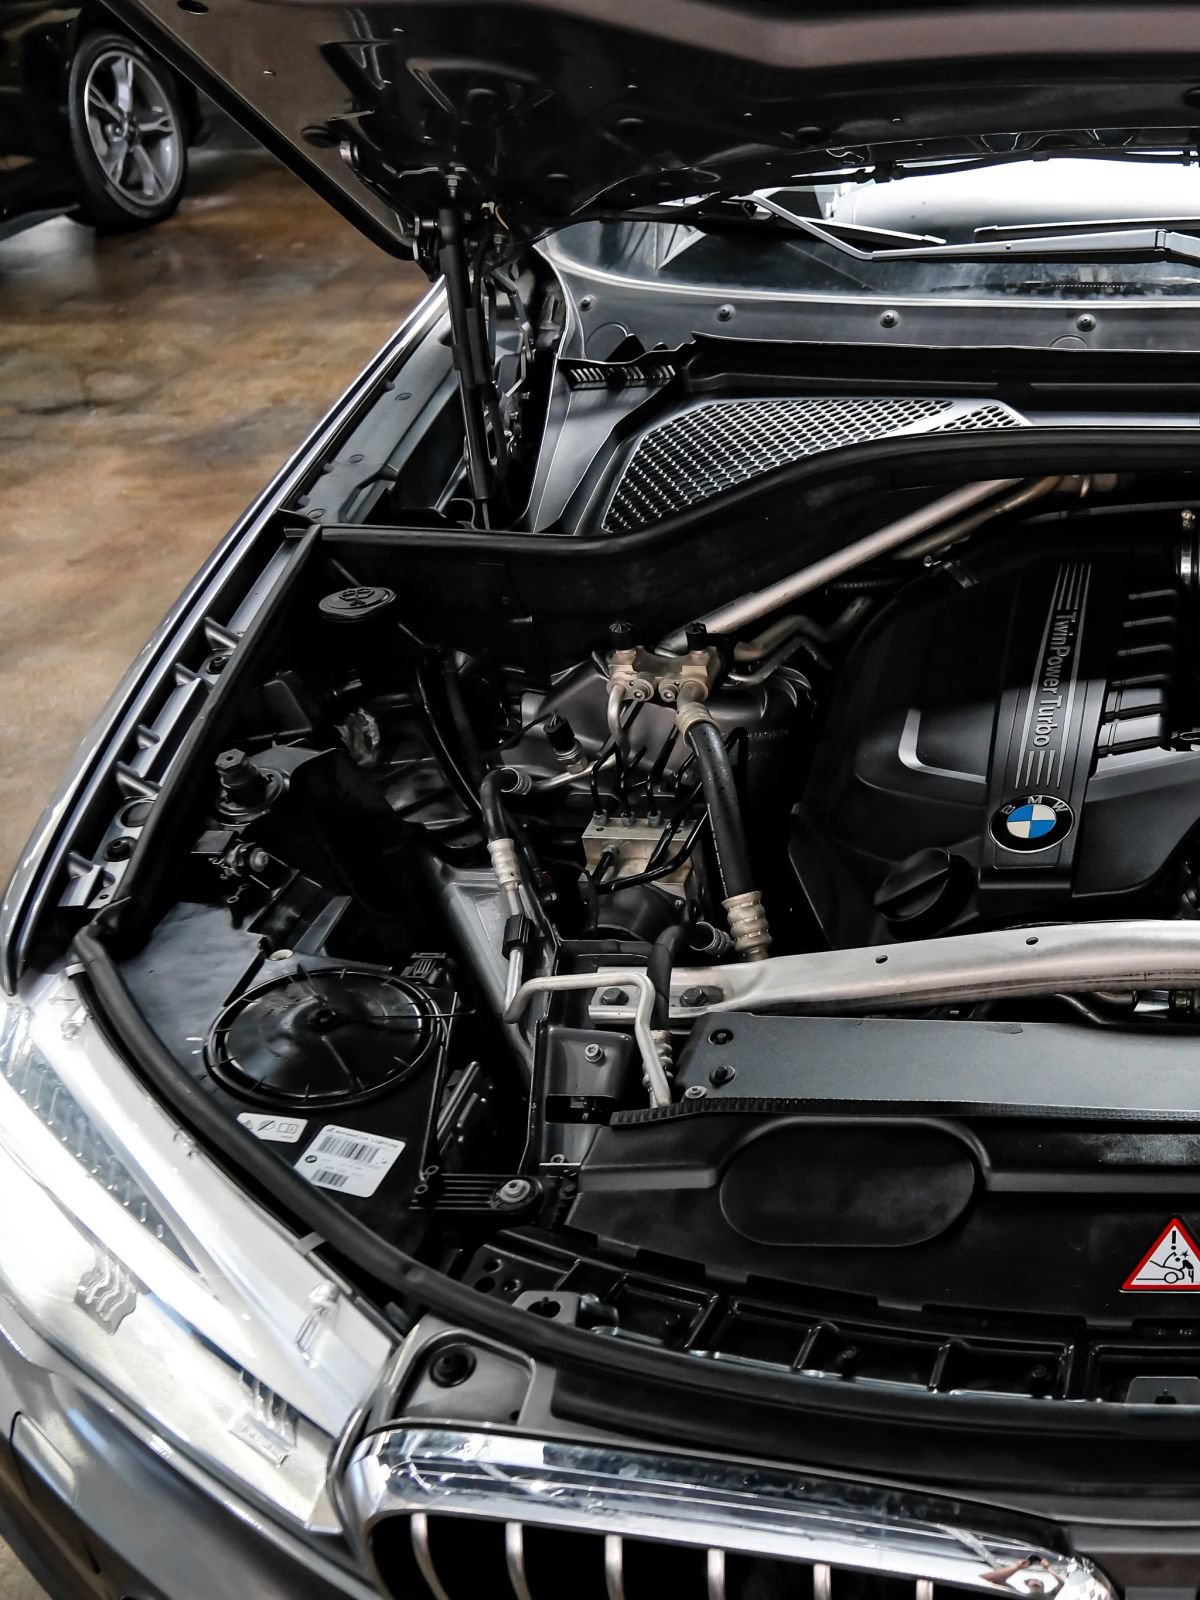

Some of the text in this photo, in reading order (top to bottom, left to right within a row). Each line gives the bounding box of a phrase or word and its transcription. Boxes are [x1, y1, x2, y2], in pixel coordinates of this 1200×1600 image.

[1033, 611, 1077, 747] TwinPower Turbo
[1000, 795, 1069, 815] BMW
